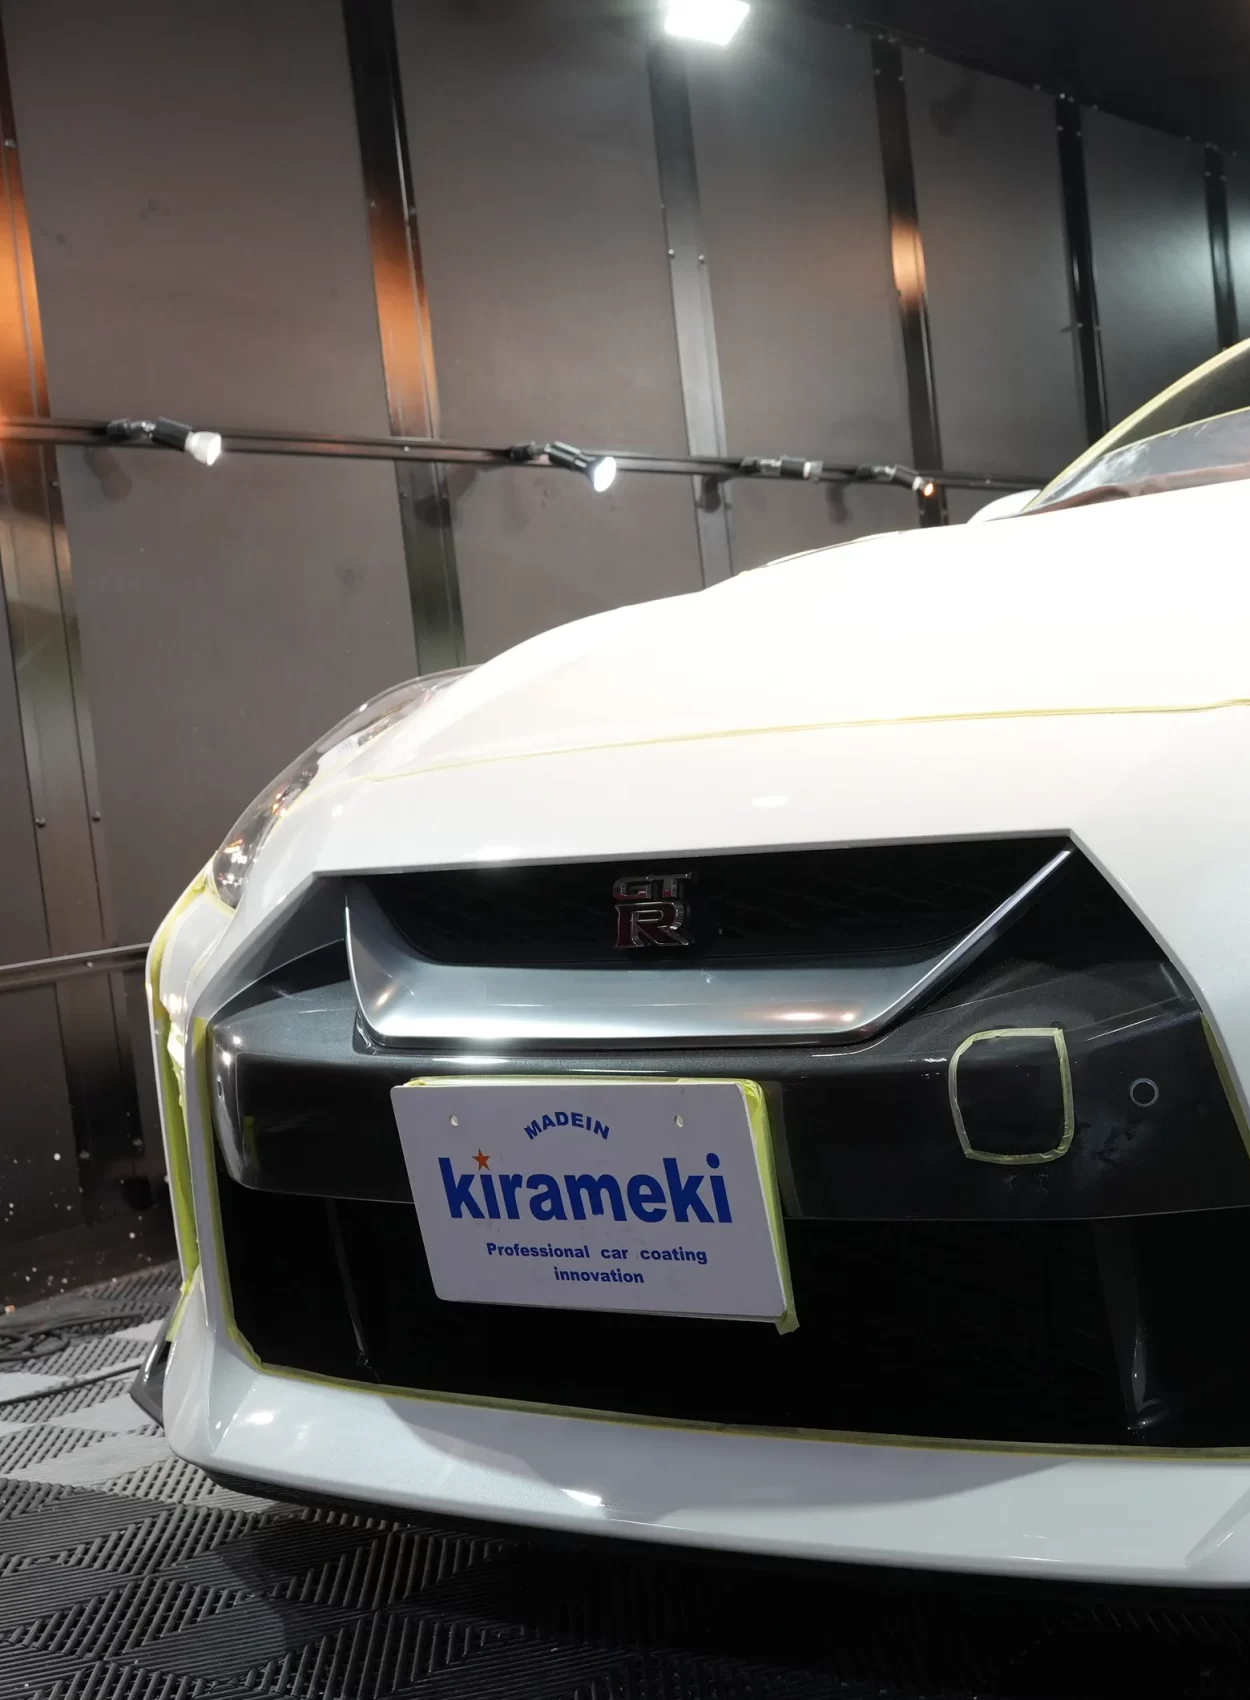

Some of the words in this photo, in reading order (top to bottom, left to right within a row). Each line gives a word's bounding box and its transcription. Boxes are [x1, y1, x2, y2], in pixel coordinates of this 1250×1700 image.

[612, 871, 692, 900] GT
[615, 901, 689, 948] R
[524, 1111, 610, 1140] MADEIN
[438, 1150, 732, 1223] kirameki
[486, 1242, 590, 1260] Professional
[600, 1247, 629, 1260] car
[640, 1246, 708, 1265] coating
[554, 1266, 644, 1284] innovation
